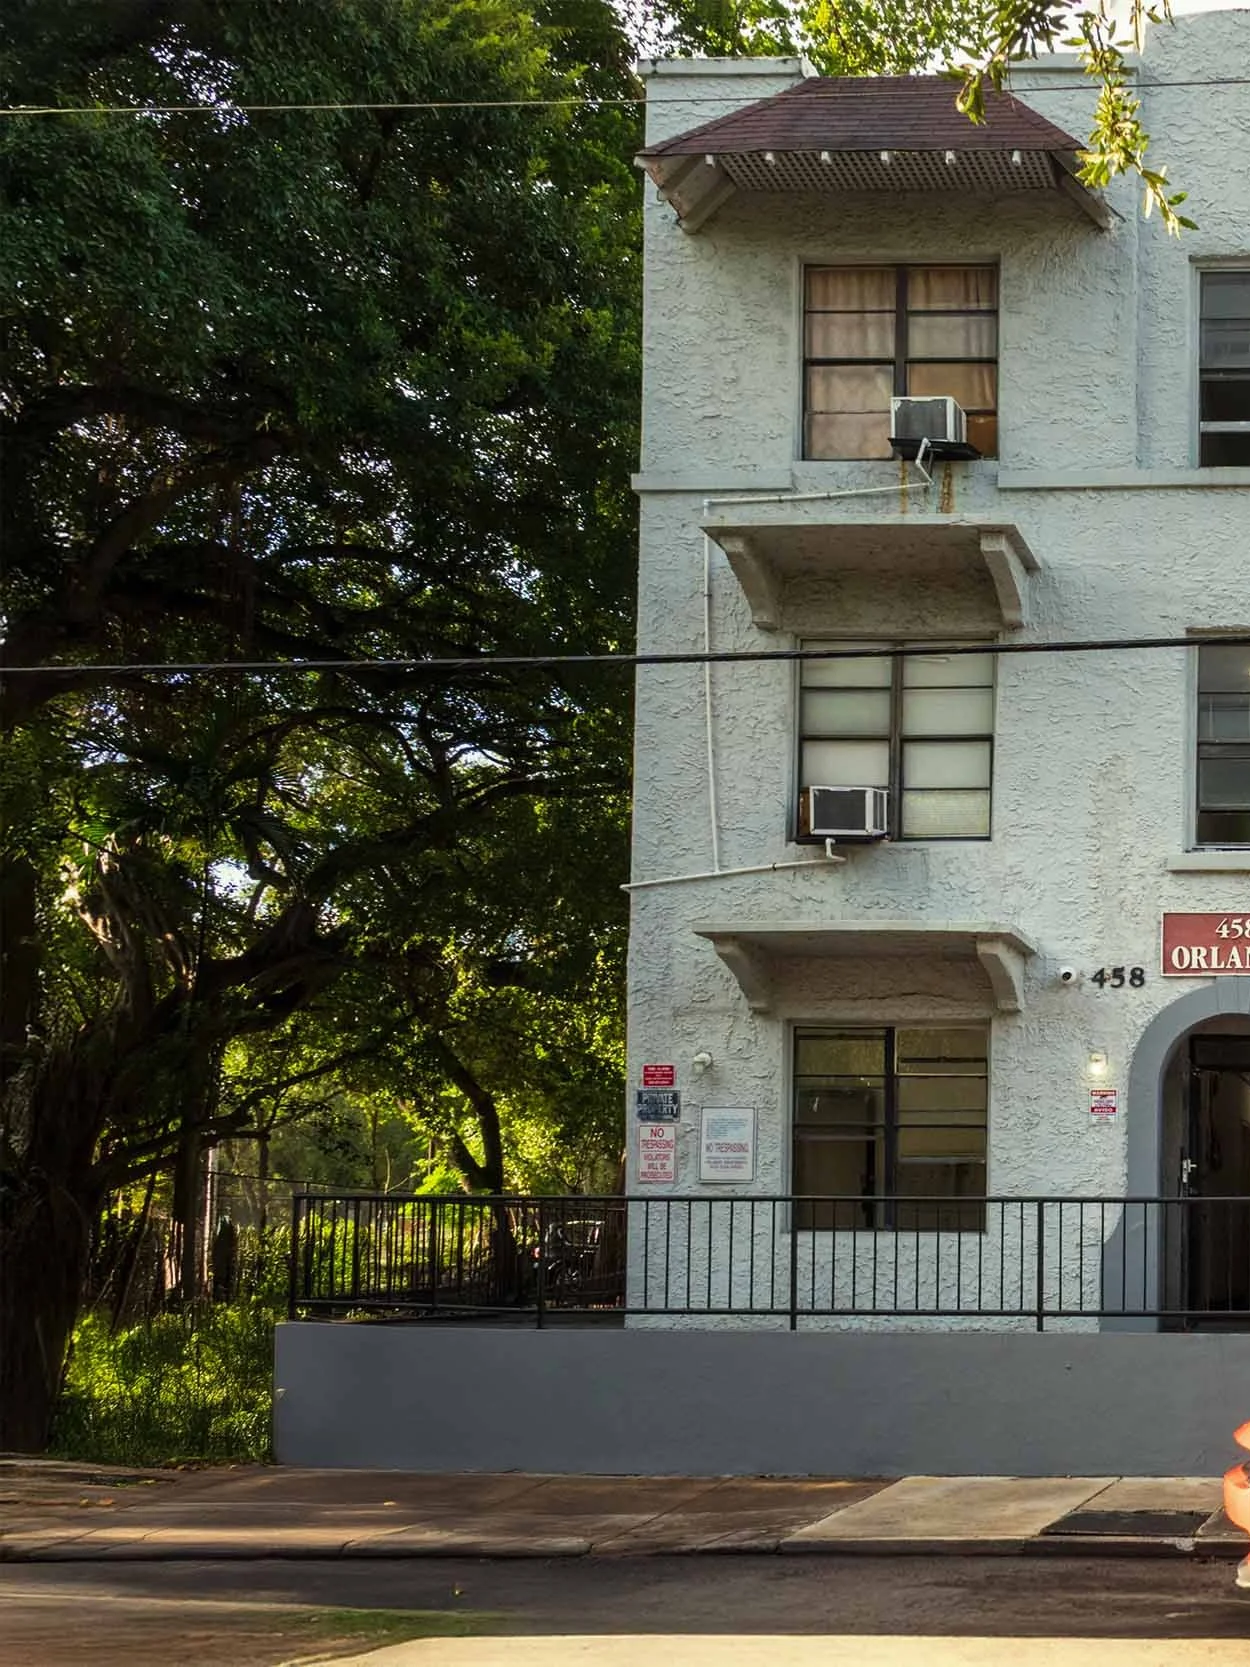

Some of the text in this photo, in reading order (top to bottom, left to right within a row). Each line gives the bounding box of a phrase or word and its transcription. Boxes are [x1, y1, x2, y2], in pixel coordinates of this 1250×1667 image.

[1091, 966, 1146, 989] 458
[642, 1093, 673, 1104] PRIVATE
[638, 1104, 678, 1114] PROPERTY
[650, 1127, 665, 1138] NO
[641, 1139, 674, 1149] TRESPASSING
[705, 1142, 713, 1152] NO
[715, 1142, 749, 1153] TRESPASSING
